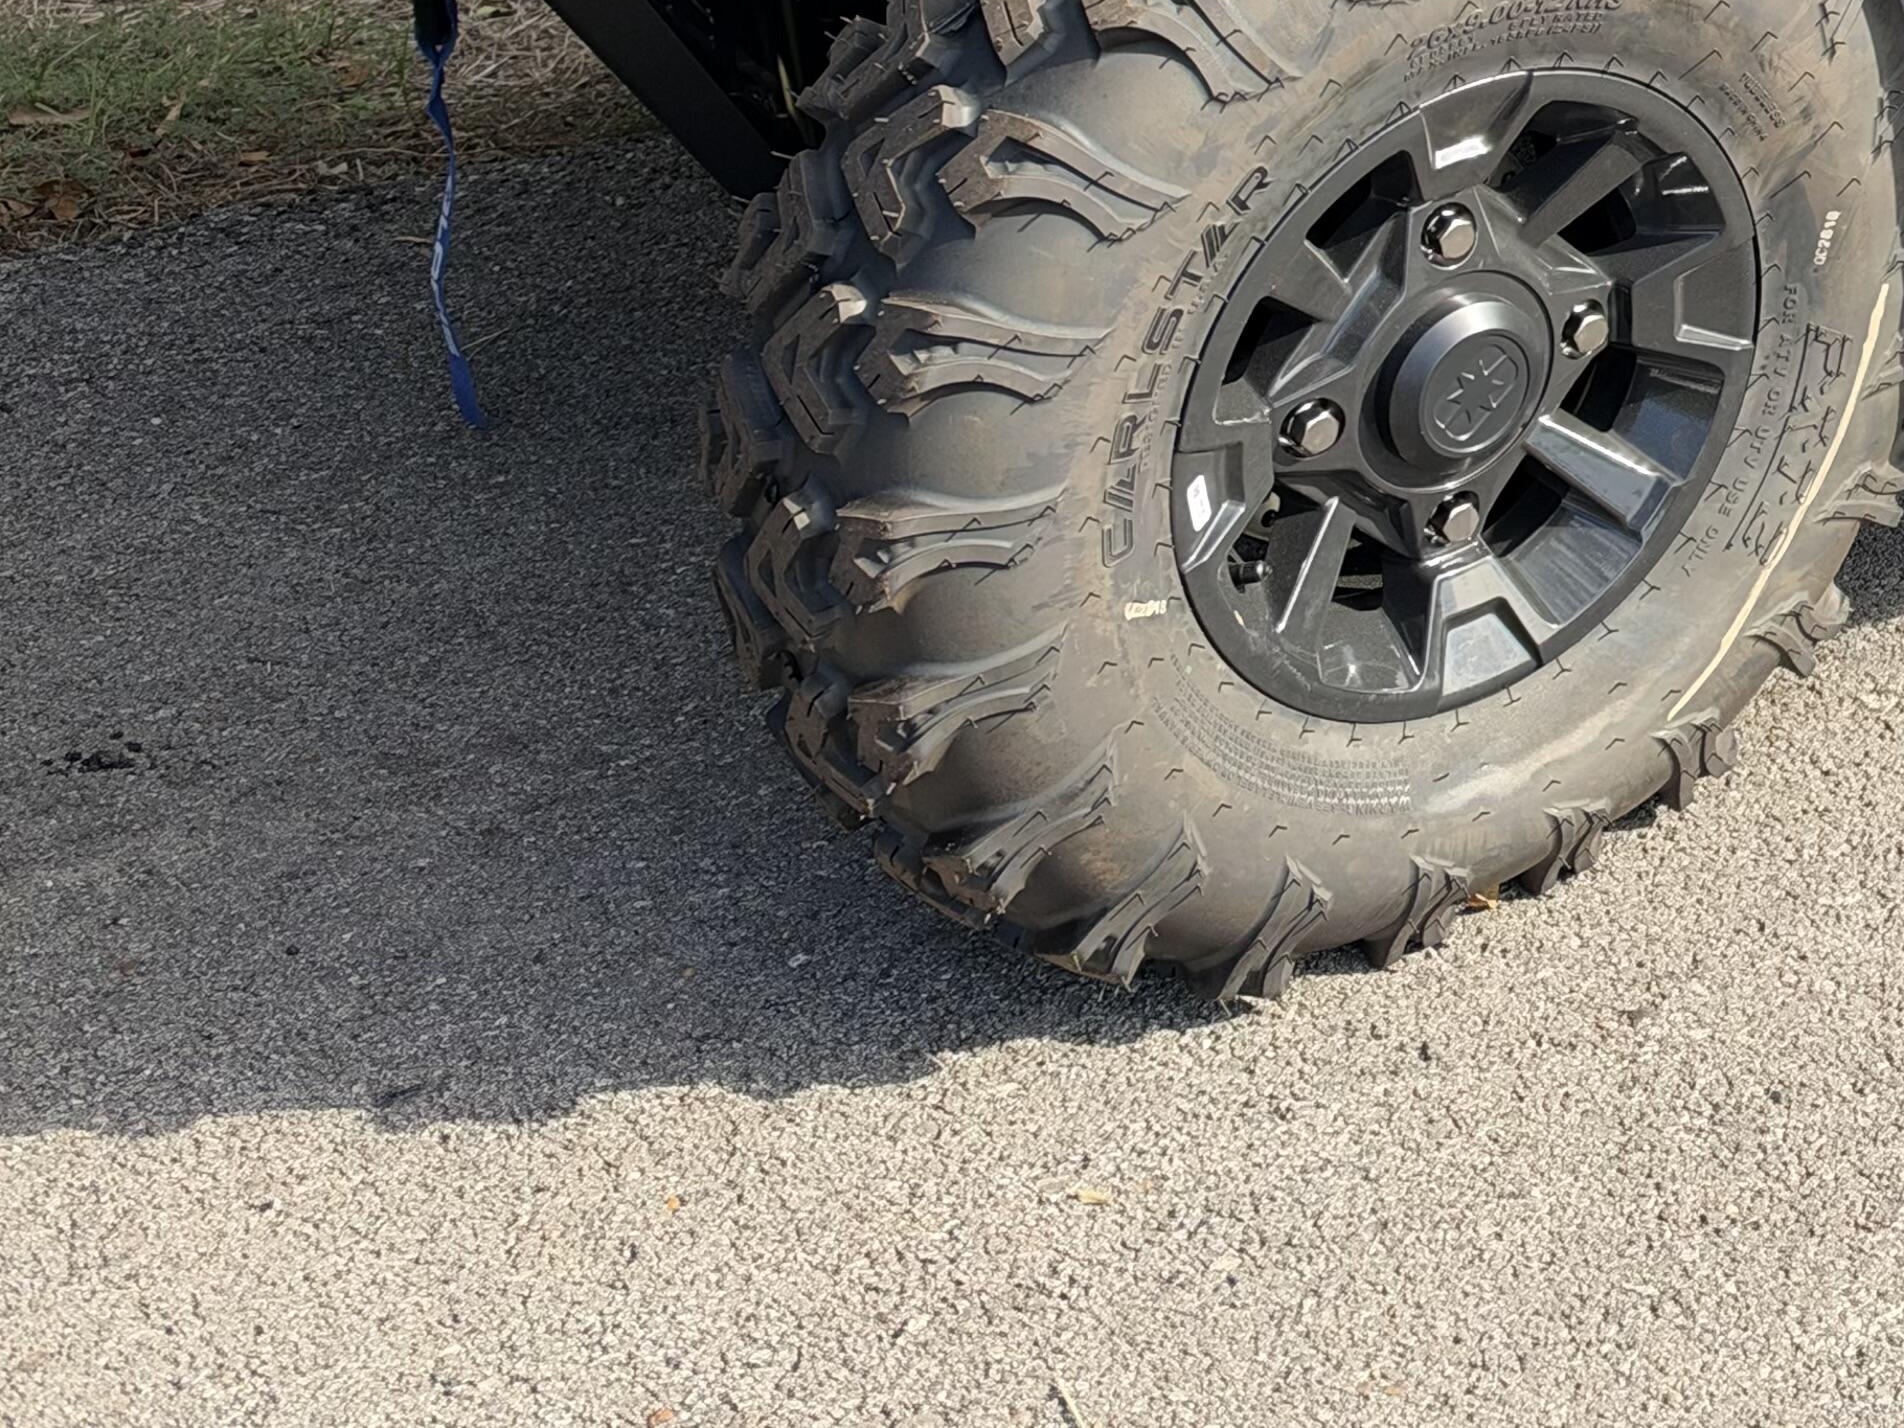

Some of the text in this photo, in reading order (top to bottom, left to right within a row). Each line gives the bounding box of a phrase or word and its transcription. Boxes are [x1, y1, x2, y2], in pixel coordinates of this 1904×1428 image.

[1102, 165, 1270, 568] CARLSTAR
[1683, 284, 1798, 578] FOR ATV OR UTV USE ONLY
